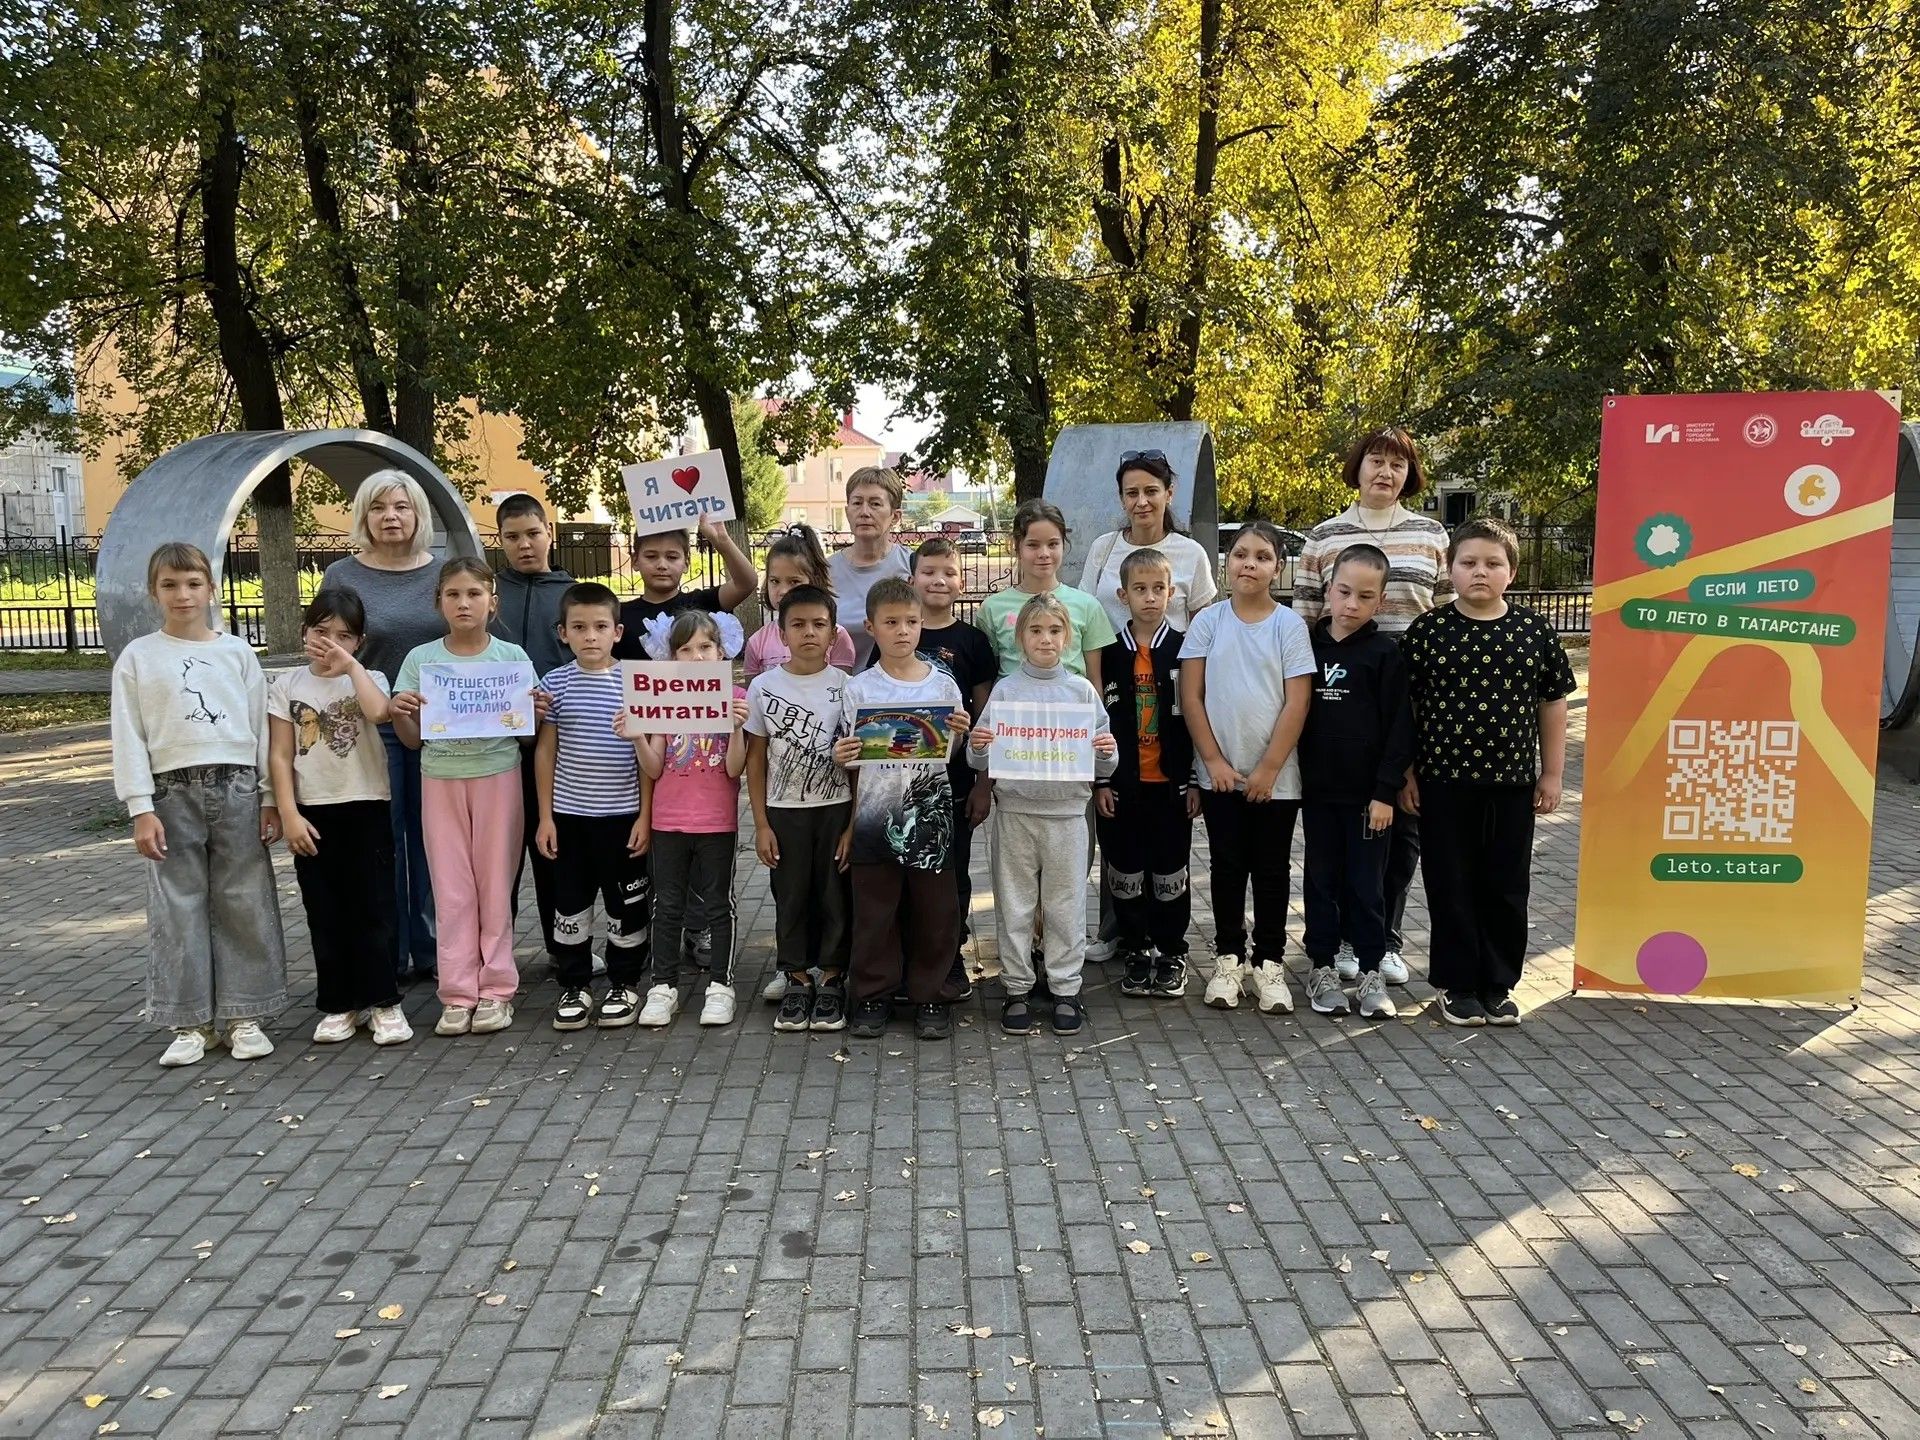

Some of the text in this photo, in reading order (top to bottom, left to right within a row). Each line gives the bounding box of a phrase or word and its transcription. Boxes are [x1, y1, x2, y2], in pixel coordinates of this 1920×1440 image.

[644, 476, 659, 496] Я
[639, 496, 726, 523] читать
[1705, 578, 1799, 597] ЕСЛИ ЛЕТО
[1637, 608, 1841, 638] ТО ЛЕТО В ТАТАРСТАНЕ
[434, 672, 520, 689] ПУТЕШЕСТВИЕ
[633, 673, 721, 696] Время
[449, 689, 505, 701] В СТРАНУ
[451, 701, 512, 714] ЧИТАЛИЮ
[629, 701, 728, 719] читать!
[996, 722, 1088, 741] Литературная
[1004, 747, 1077, 762] скамейка
[1667, 858, 1782, 875] leto.tatar
